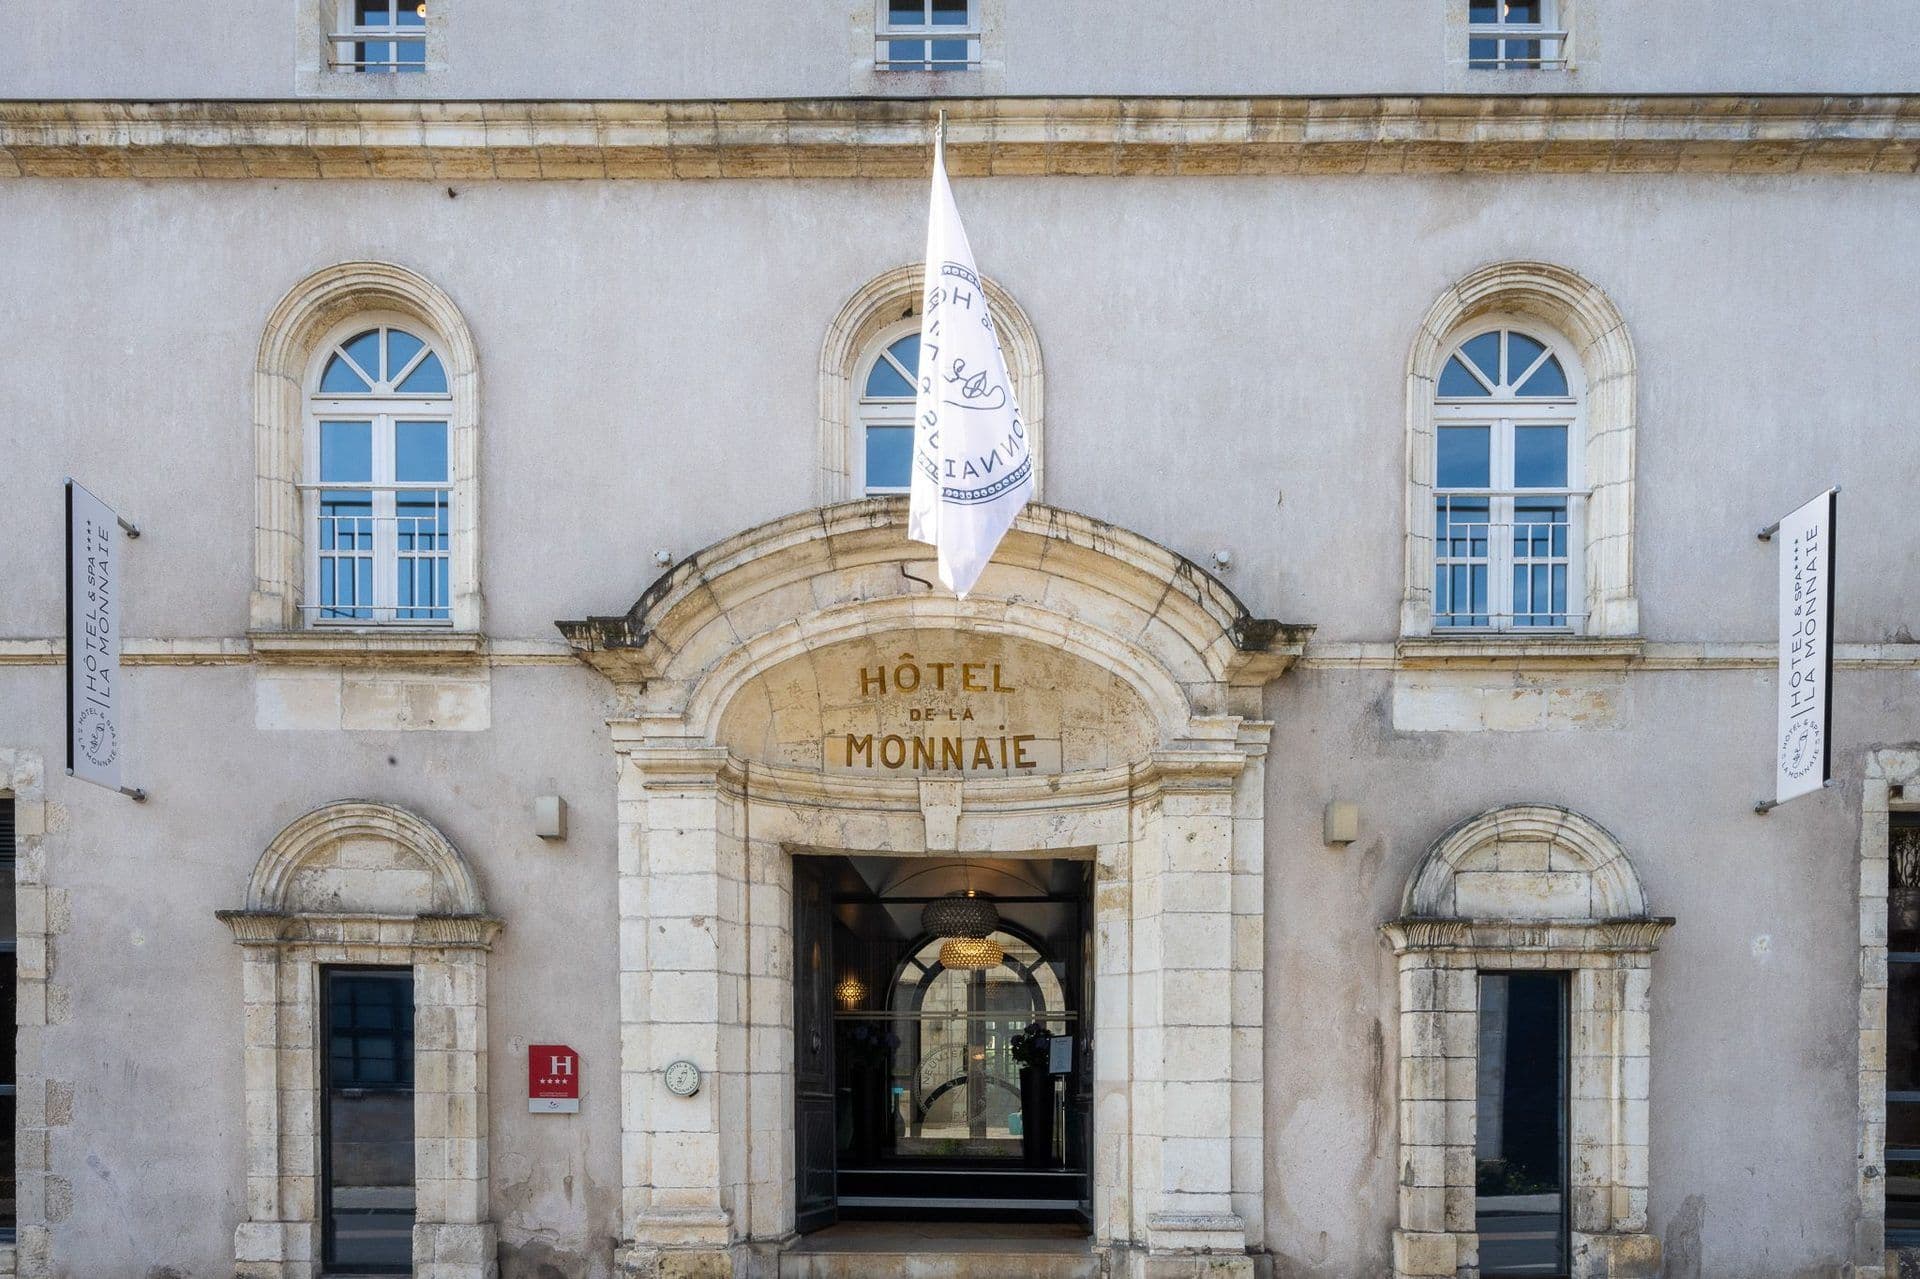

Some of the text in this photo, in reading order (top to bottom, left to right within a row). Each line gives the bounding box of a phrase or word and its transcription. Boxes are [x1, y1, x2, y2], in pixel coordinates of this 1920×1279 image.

[84, 557, 97, 692] HÔTEL & SPA
[98, 526, 111, 698] LA MONNAIE
[1788, 570, 1802, 708] HÔTEL & SPA
[1804, 525, 1818, 702] LA MONNAIE
[860, 653, 1015, 696] HÔTEL
[909, 707, 975, 722] DE LA
[846, 733, 1037, 770] MONNAIE
[550, 1055, 573, 1076] H
